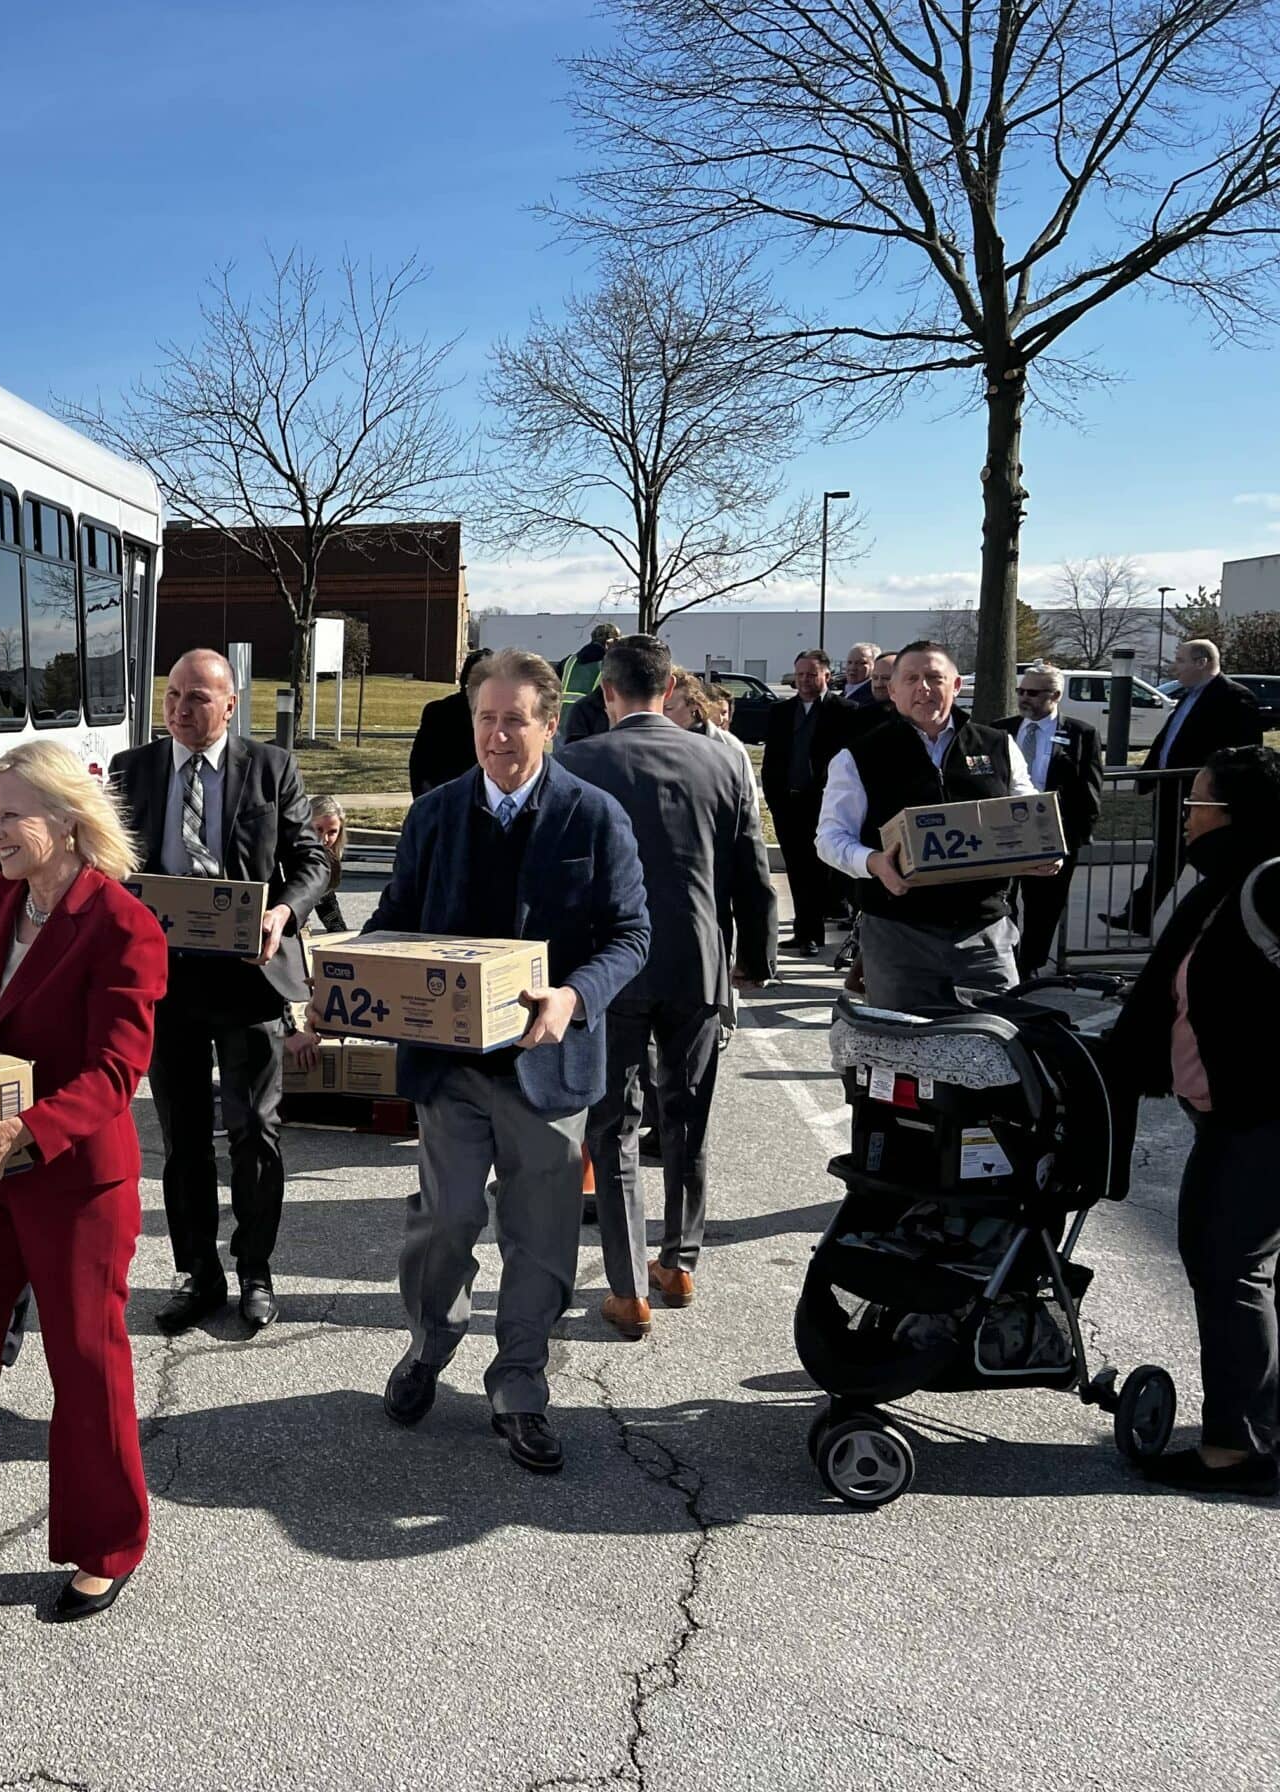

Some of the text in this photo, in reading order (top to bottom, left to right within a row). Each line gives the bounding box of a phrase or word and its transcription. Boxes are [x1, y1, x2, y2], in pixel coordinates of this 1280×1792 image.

[922, 829, 983, 861] A2+
[325, 964, 352, 978] Care
[323, 985, 390, 1028] A2+
